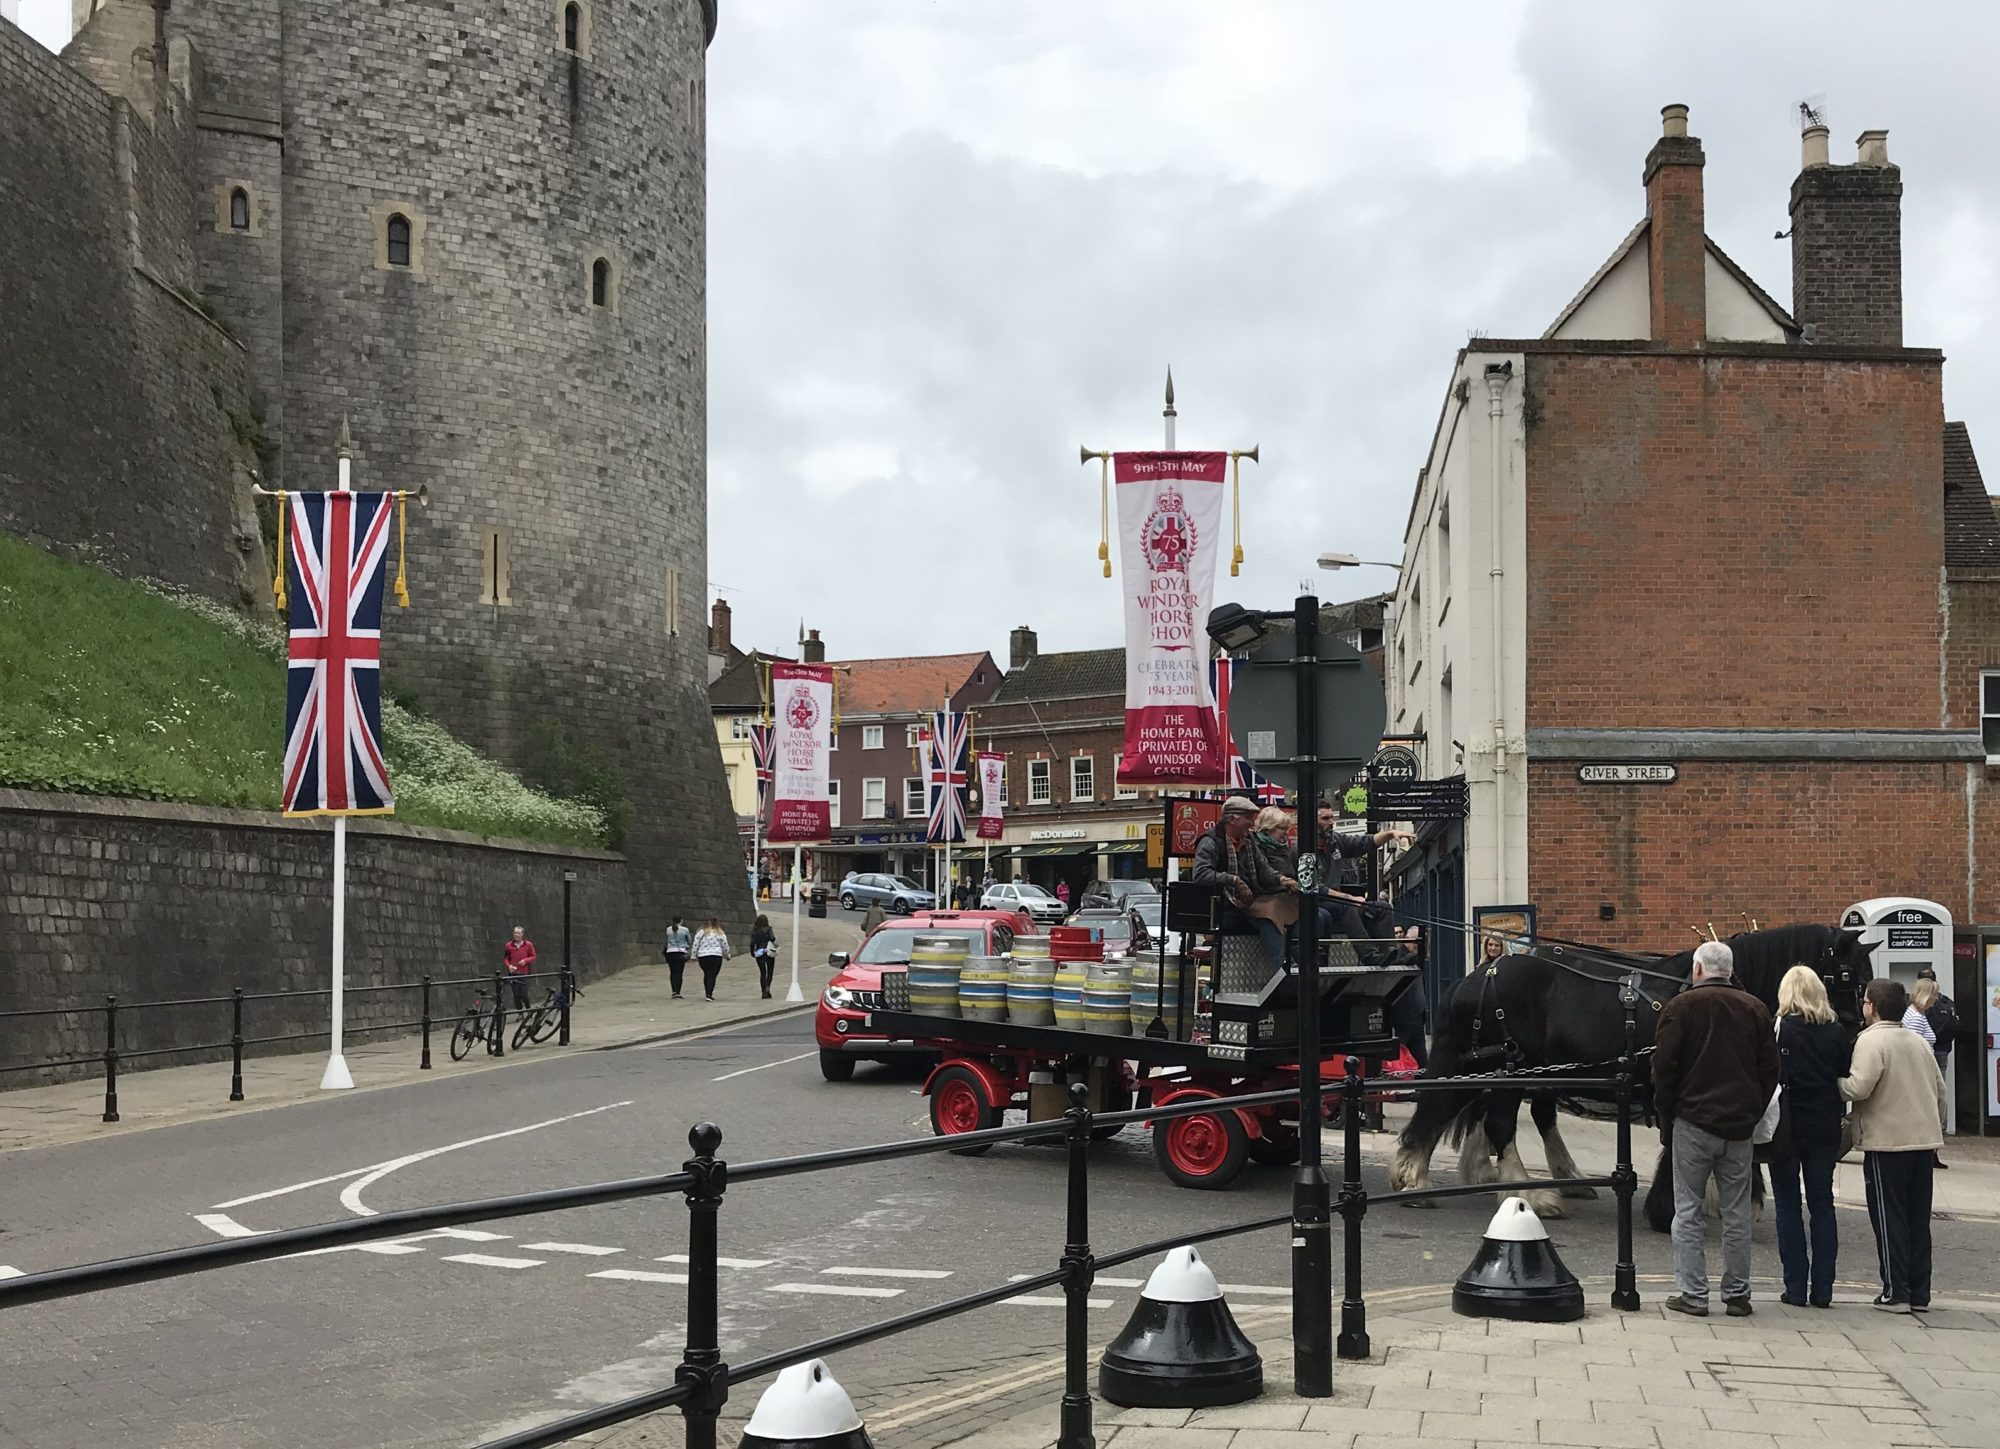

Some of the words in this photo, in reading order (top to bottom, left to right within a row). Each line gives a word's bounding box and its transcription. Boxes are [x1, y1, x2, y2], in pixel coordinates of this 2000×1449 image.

[1182, 461, 1206, 473] MAY
[1163, 534, 1180, 551] 75
[1137, 593, 1199, 609] WINDSOR
[1151, 609, 1193, 625] HORSE
[1164, 671, 1195, 681] YEAR
[1164, 714, 1184, 725] THE
[1141, 728, 1175, 738] HOME
[1138, 740, 1192, 753] (PRIVATE)
[1148, 754, 1201, 764] WINDSOR
[1378, 765, 1413, 777] Zizzi
[1584, 767, 1620, 778] RIVER
[1626, 767, 1671, 778] STREET
[1897, 911, 1922, 923] free
